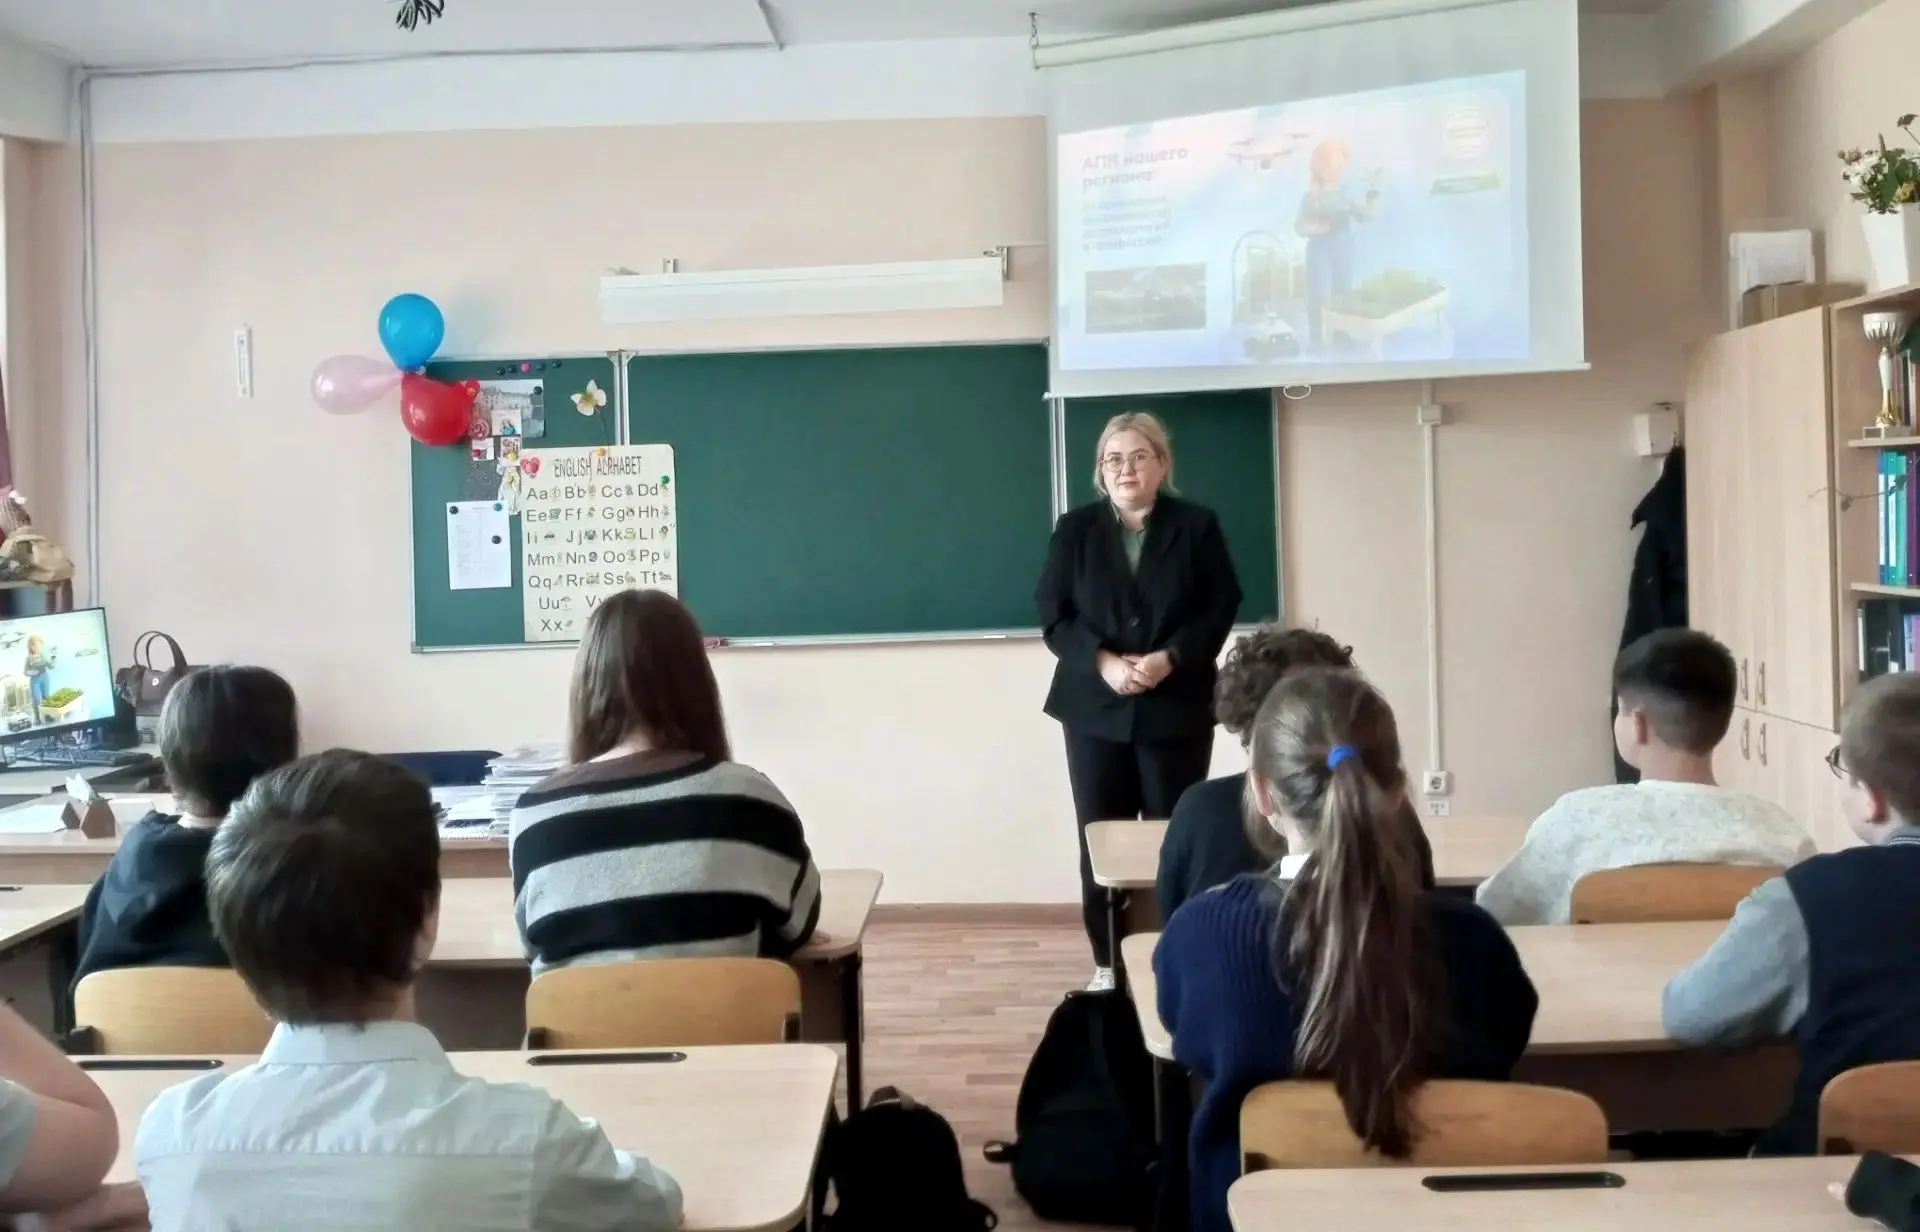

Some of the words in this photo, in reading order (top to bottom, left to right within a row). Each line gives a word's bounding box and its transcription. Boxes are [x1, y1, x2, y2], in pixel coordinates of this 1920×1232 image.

[554, 456, 591, 478] ENGLISH
[527, 488, 548, 500] Aa
[565, 486, 585, 499] Bb
[601, 485, 623, 498] Cc
[638, 483, 658, 496] Dd
[527, 509, 547, 522] Ee
[565, 508, 582, 521] Ff
[602, 507, 625, 522] Gg
[639, 506, 659, 518] Hh
[527, 532, 538, 544] Ii
[566, 530, 582, 546] Jj
[602, 528, 622, 541] Kk
[639, 527, 654, 540] Ll
[527, 553, 555, 566] Mm
[566, 552, 586, 564] Nn
[603, 551, 625, 563] Oo
[639, 550, 660, 564] Pp
[528, 575, 551, 590] Qq
[566, 574, 585, 586] Rr
[603, 572, 624, 585] Ss
[640, 571, 657, 584] Tt
[538, 597, 560, 610] Uu
[541, 619, 563, 632] Xx
